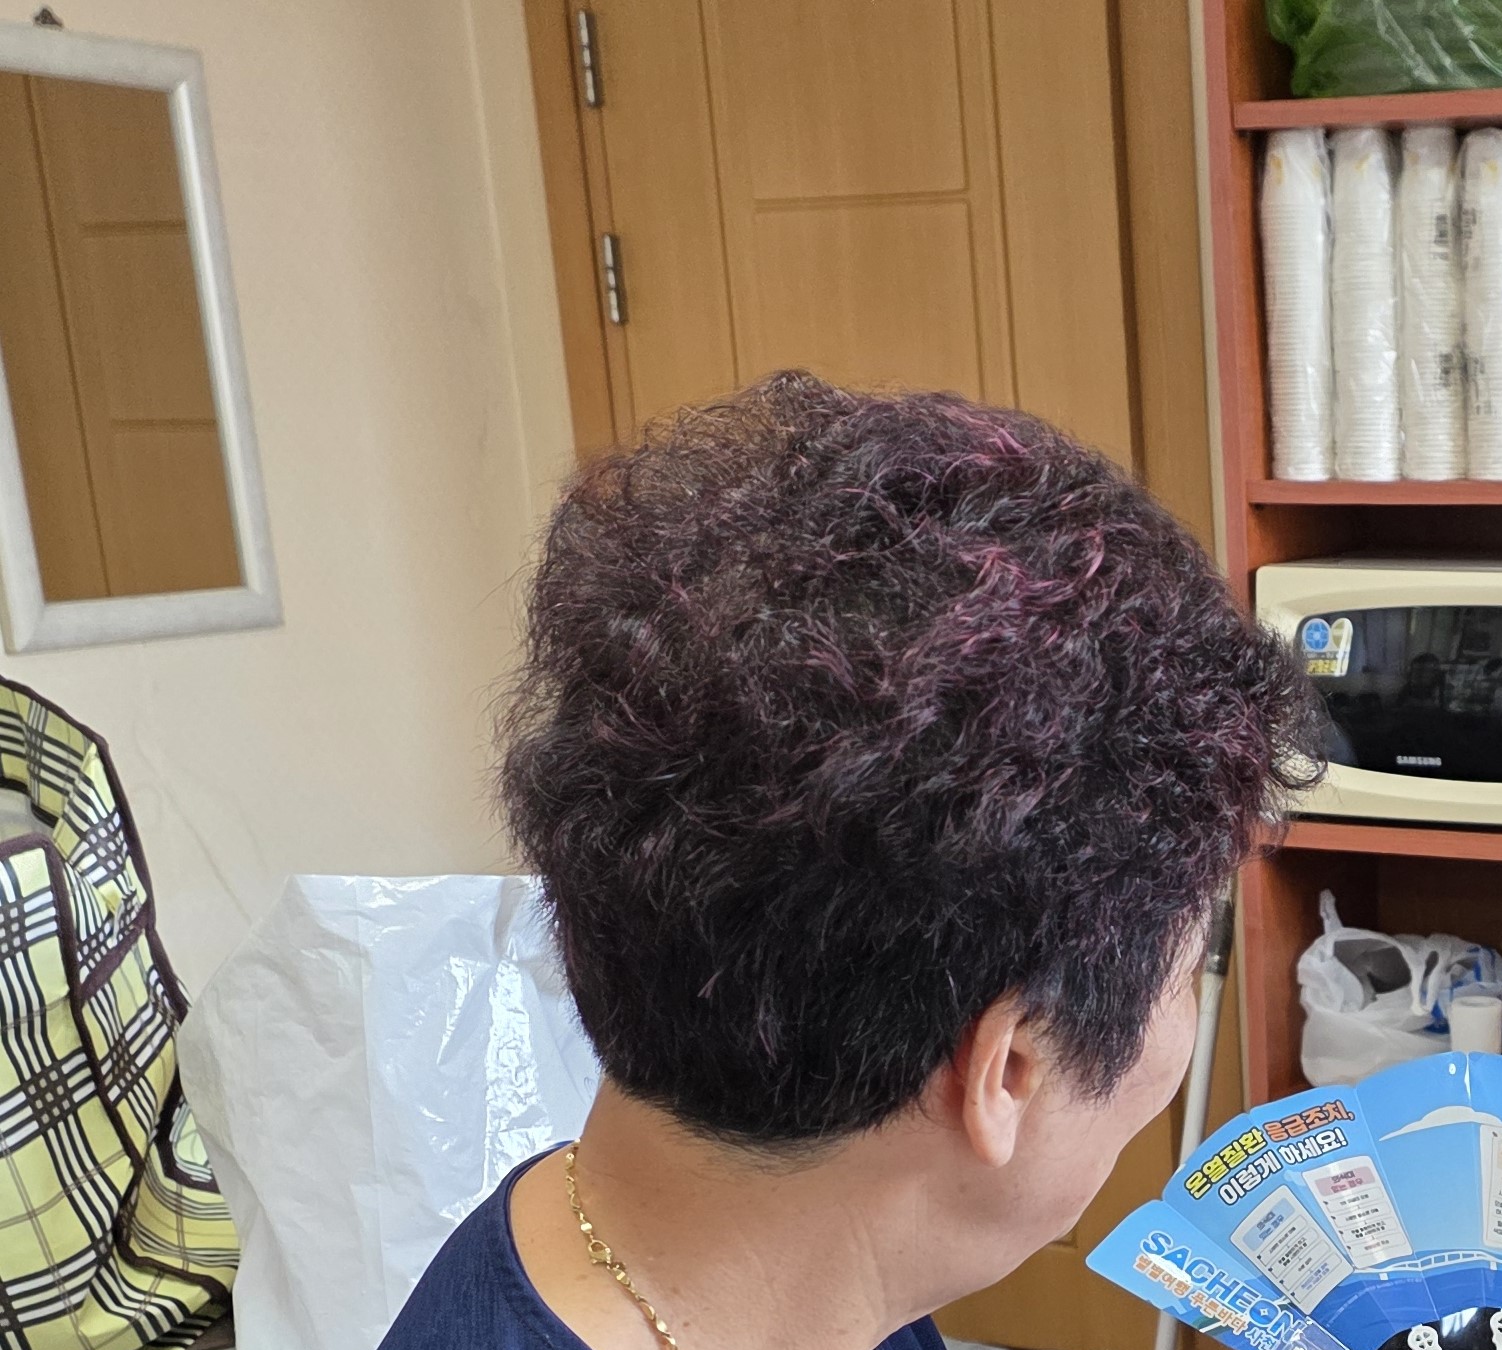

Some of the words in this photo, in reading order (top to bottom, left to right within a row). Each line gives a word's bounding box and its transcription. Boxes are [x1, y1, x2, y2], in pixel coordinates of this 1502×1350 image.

[1396, 755, 1442, 766] SAMSUNG
[1184, 1126, 1268, 1200] 온열질환
[1263, 1099, 1355, 1142] 응급조치,
[1218, 1149, 1283, 1206] 이렇게
[1278, 1127, 1348, 1165] 하세요!
[1133, 1254, 1193, 1298] 별별여행
[1189, 1289, 1249, 1336] 푸른바다
[1140, 1231, 1307, 1344] SACHEON
